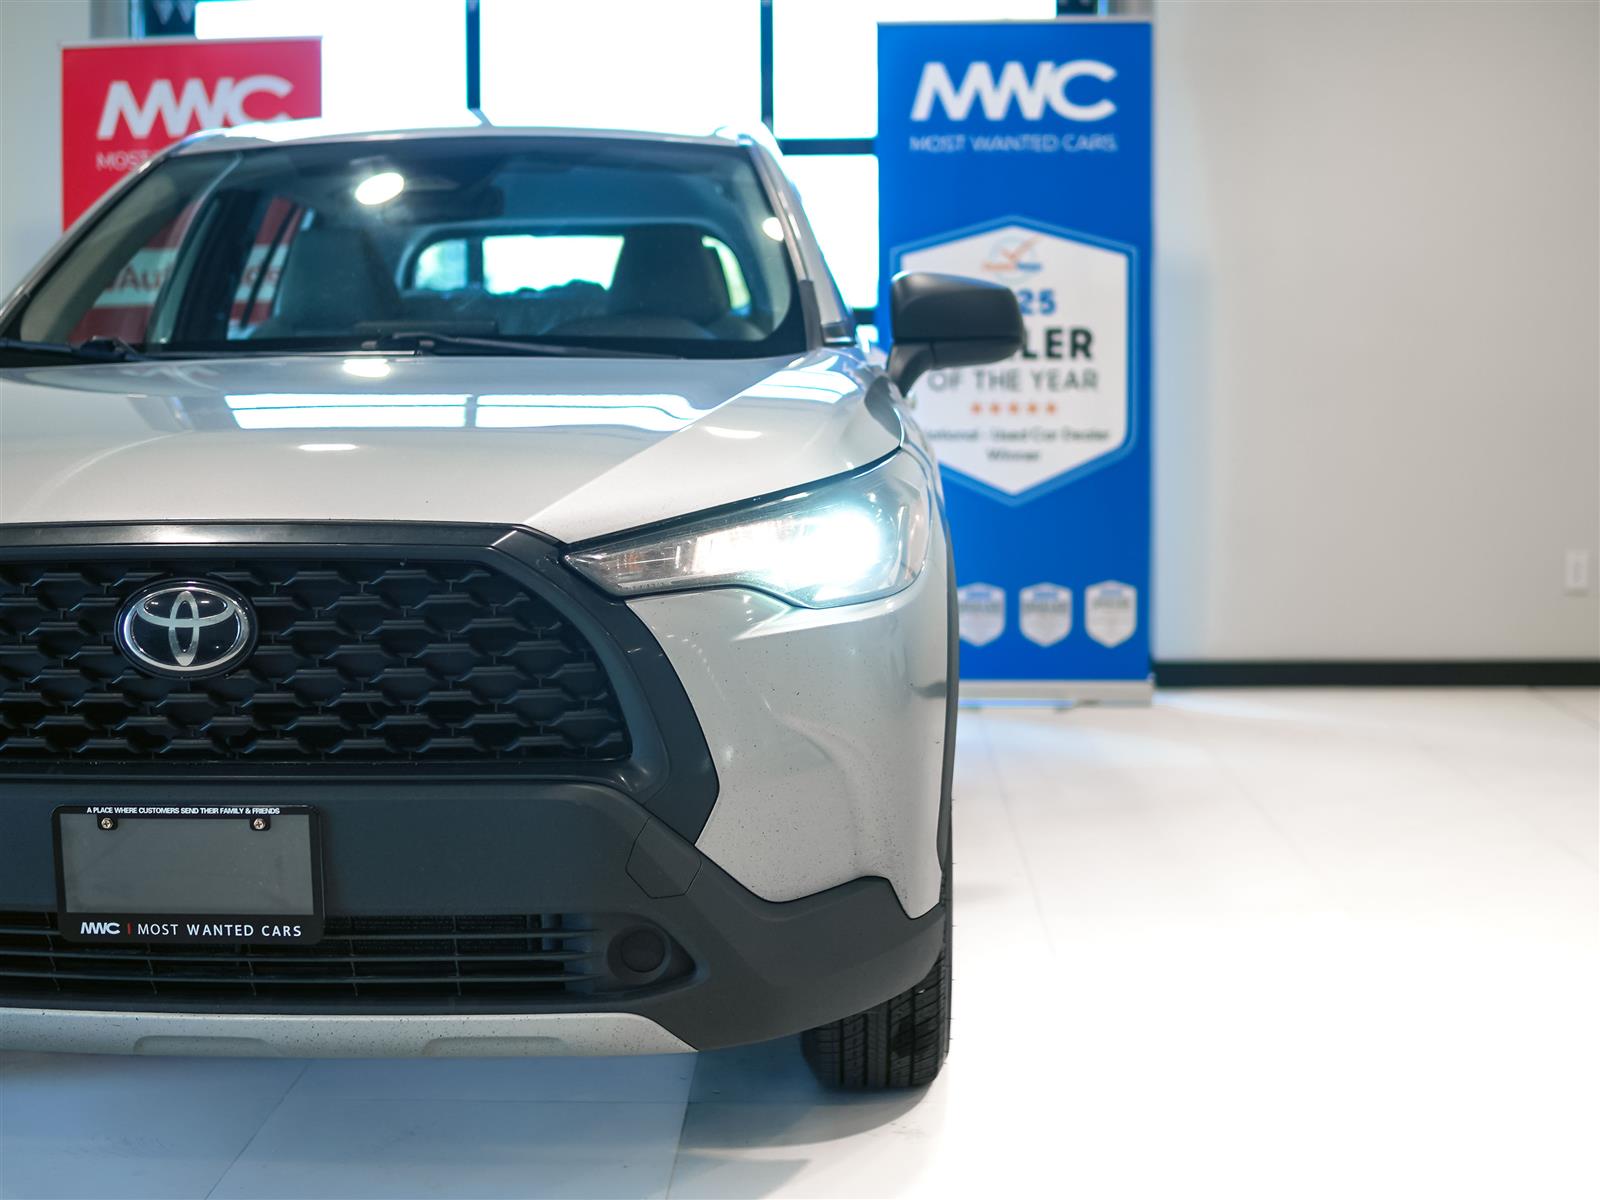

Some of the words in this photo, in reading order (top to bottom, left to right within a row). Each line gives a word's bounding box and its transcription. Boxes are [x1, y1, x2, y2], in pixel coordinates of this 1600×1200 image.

[909, 59, 1117, 122] MWC
[96, 74, 294, 140] MWC
[909, 135, 966, 151] MOST
[970, 135, 1058, 151] WANTED
[1062, 134, 1118, 151] CARS
[1017, 288, 1057, 316] 25
[1022, 327, 1093, 359] LER
[927, 370, 962, 392] OF
[974, 370, 1021, 392] THE
[1030, 369, 1099, 392] YEAR
[138, 807, 180, 815] CUSTOMERS
[180, 807, 199, 815] SEND
[200, 807, 219, 815] THEIR
[219, 807, 245, 815] FAMILY
[252, 807, 280, 815] FRIENDS
[80, 921, 121, 935] MWC
[137, 923, 179, 936] MOST
[186, 924, 254, 937] WANTED
[261, 925, 302, 937] CARS
